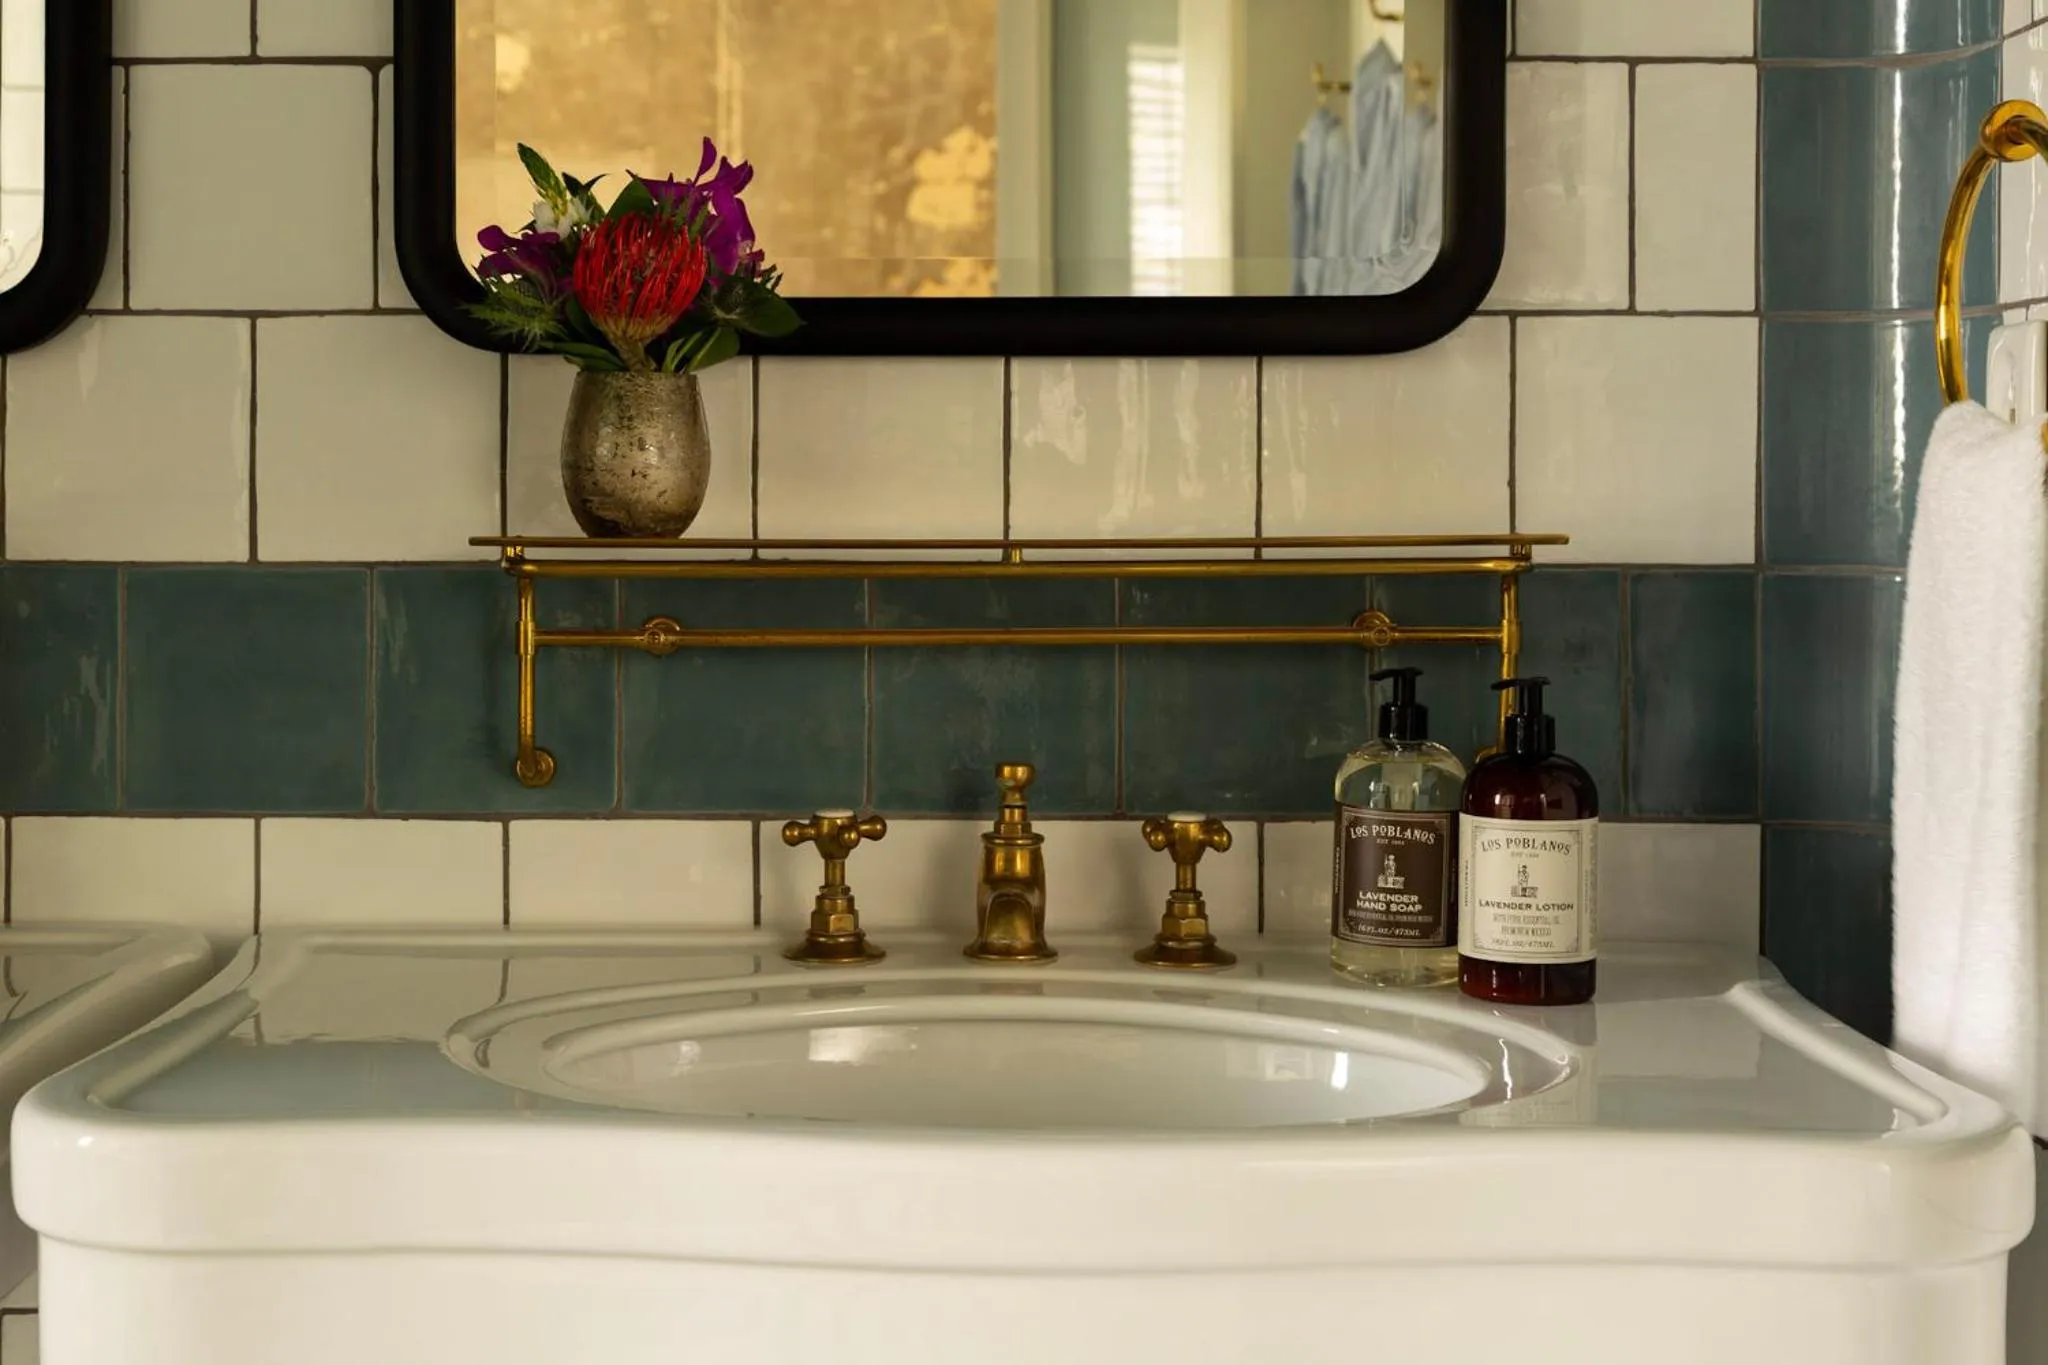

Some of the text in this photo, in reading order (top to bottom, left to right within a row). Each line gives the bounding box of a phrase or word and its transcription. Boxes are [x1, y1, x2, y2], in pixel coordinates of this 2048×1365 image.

[1350, 824, 1436, 845] LOS POBLANOS
[1481, 837, 1571, 856] LOS POBLANOS
[1359, 891, 1419, 903] LAVENDER
[1356, 899, 1423, 913] HAND SOAP
[1479, 898, 1574, 912] LAVENDER LOTION
